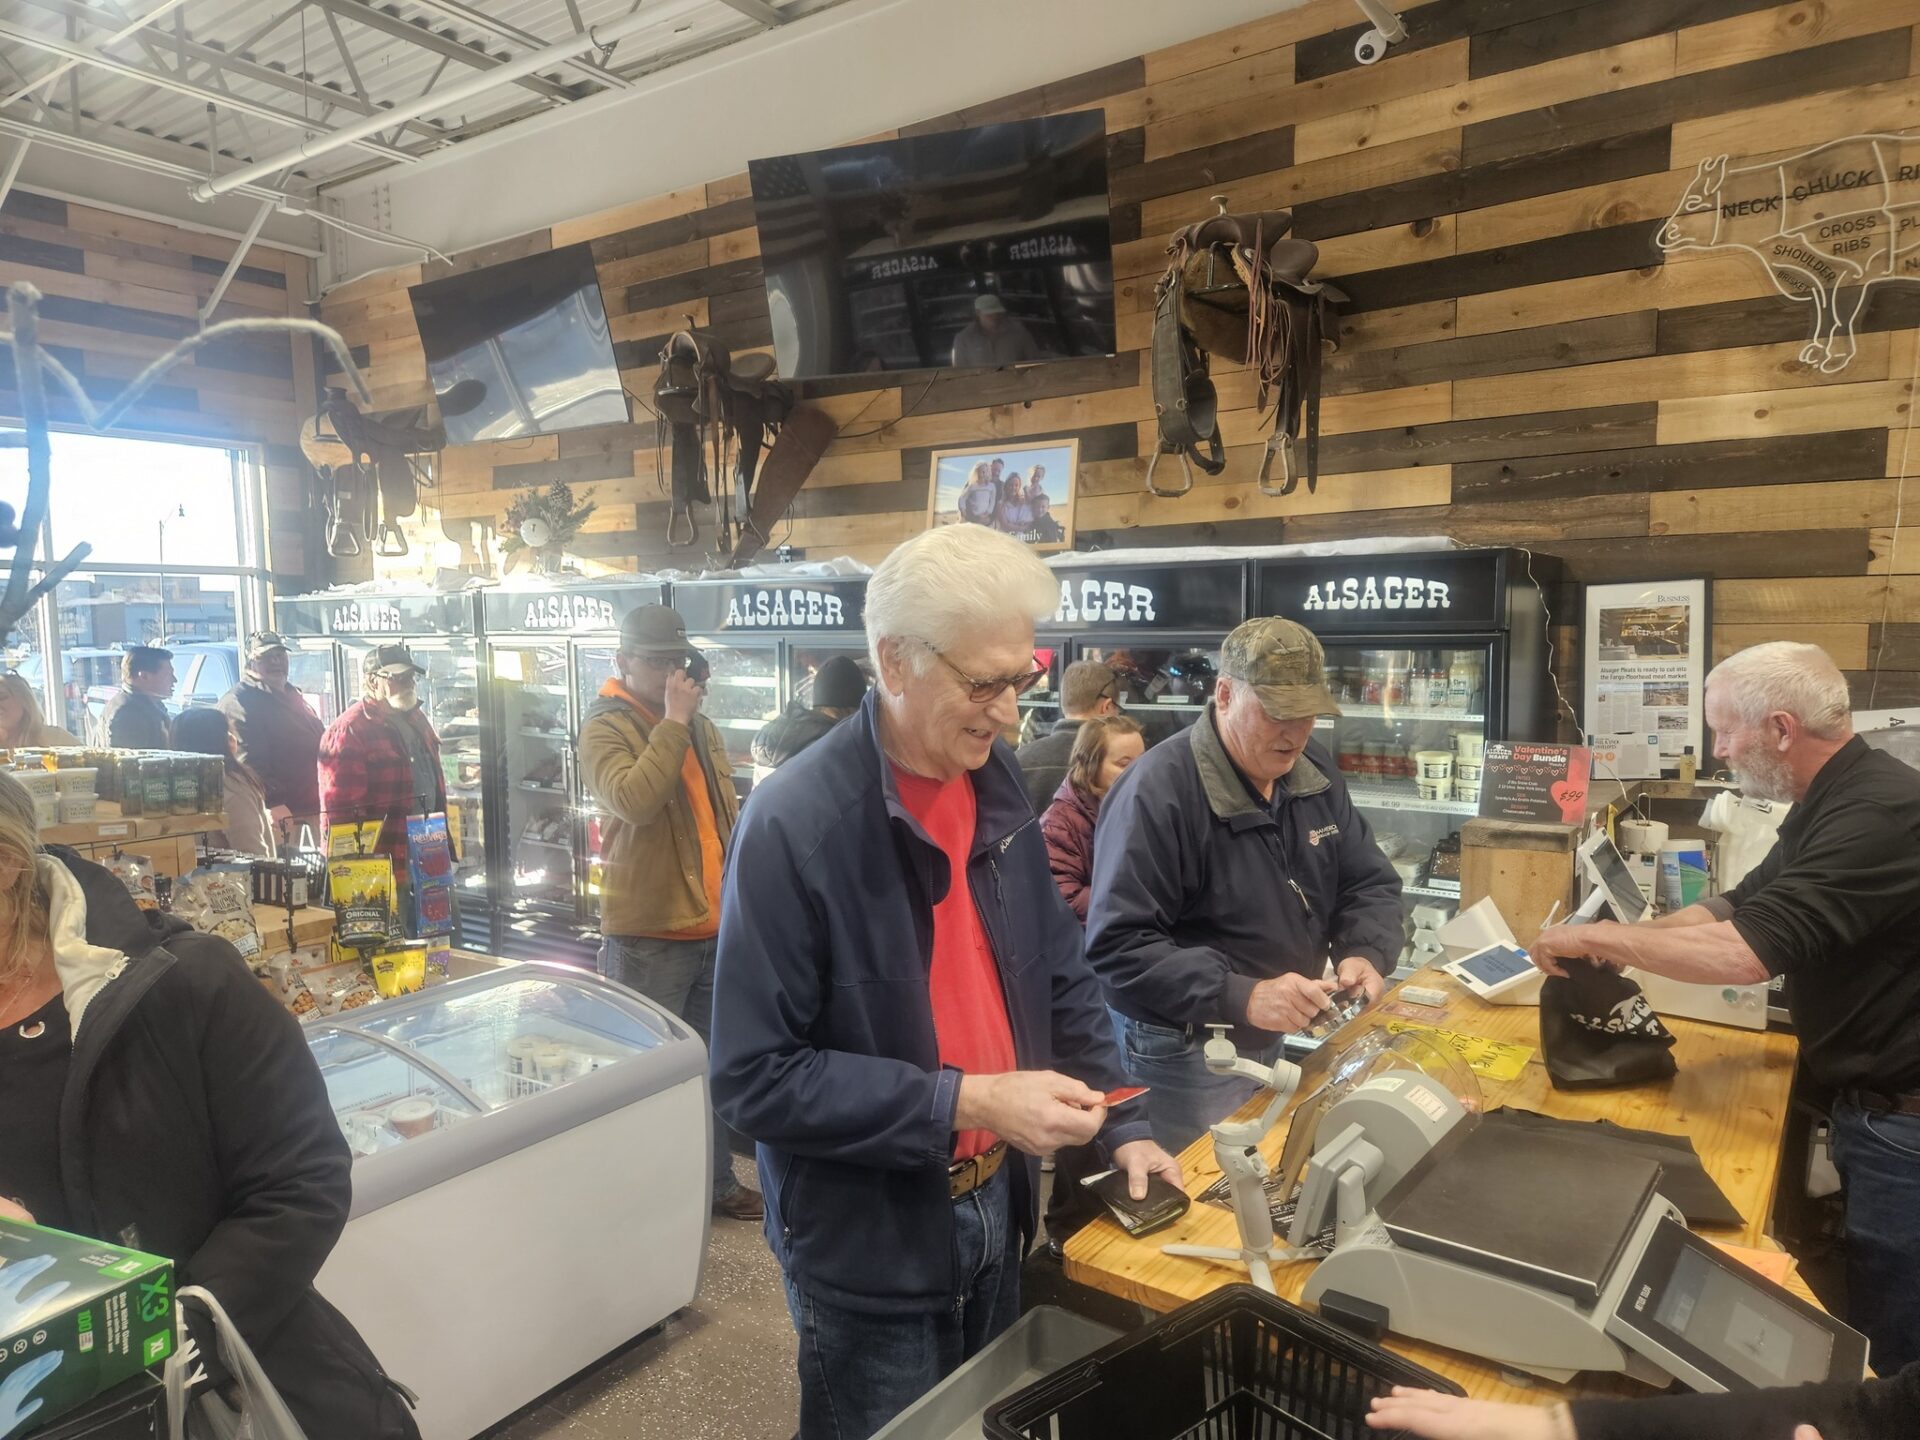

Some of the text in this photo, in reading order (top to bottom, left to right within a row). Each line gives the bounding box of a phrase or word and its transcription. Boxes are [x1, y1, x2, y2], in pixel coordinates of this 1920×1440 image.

[1792, 170, 1875, 201] CHUCK
[1722, 195, 1779, 218] NECK
[1819, 215, 1877, 239] CROSS
[1832, 236, 1872, 256] RIBS
[1772, 244, 1837, 282] SHOULDER
[1777, 270, 1810, 293] BRISKET
[1052, 579, 1157, 623] AGER
[1303, 575, 1451, 612] ALSAGER
[332, 602, 401, 632] ALSAGER
[524, 595, 616, 630] ALSAGER
[726, 589, 845, 628] ALSAGER
[1513, 753, 1567, 763] Day Bundle
[1514, 745, 1568, 755] Valentine's
[1560, 791, 1584, 802] $99
[346, 910, 380, 919] ORIGINAL
[140, 1272, 170, 1322] X3
[78, 1309, 92, 1332] 100
[150, 1337, 164, 1358] XL
